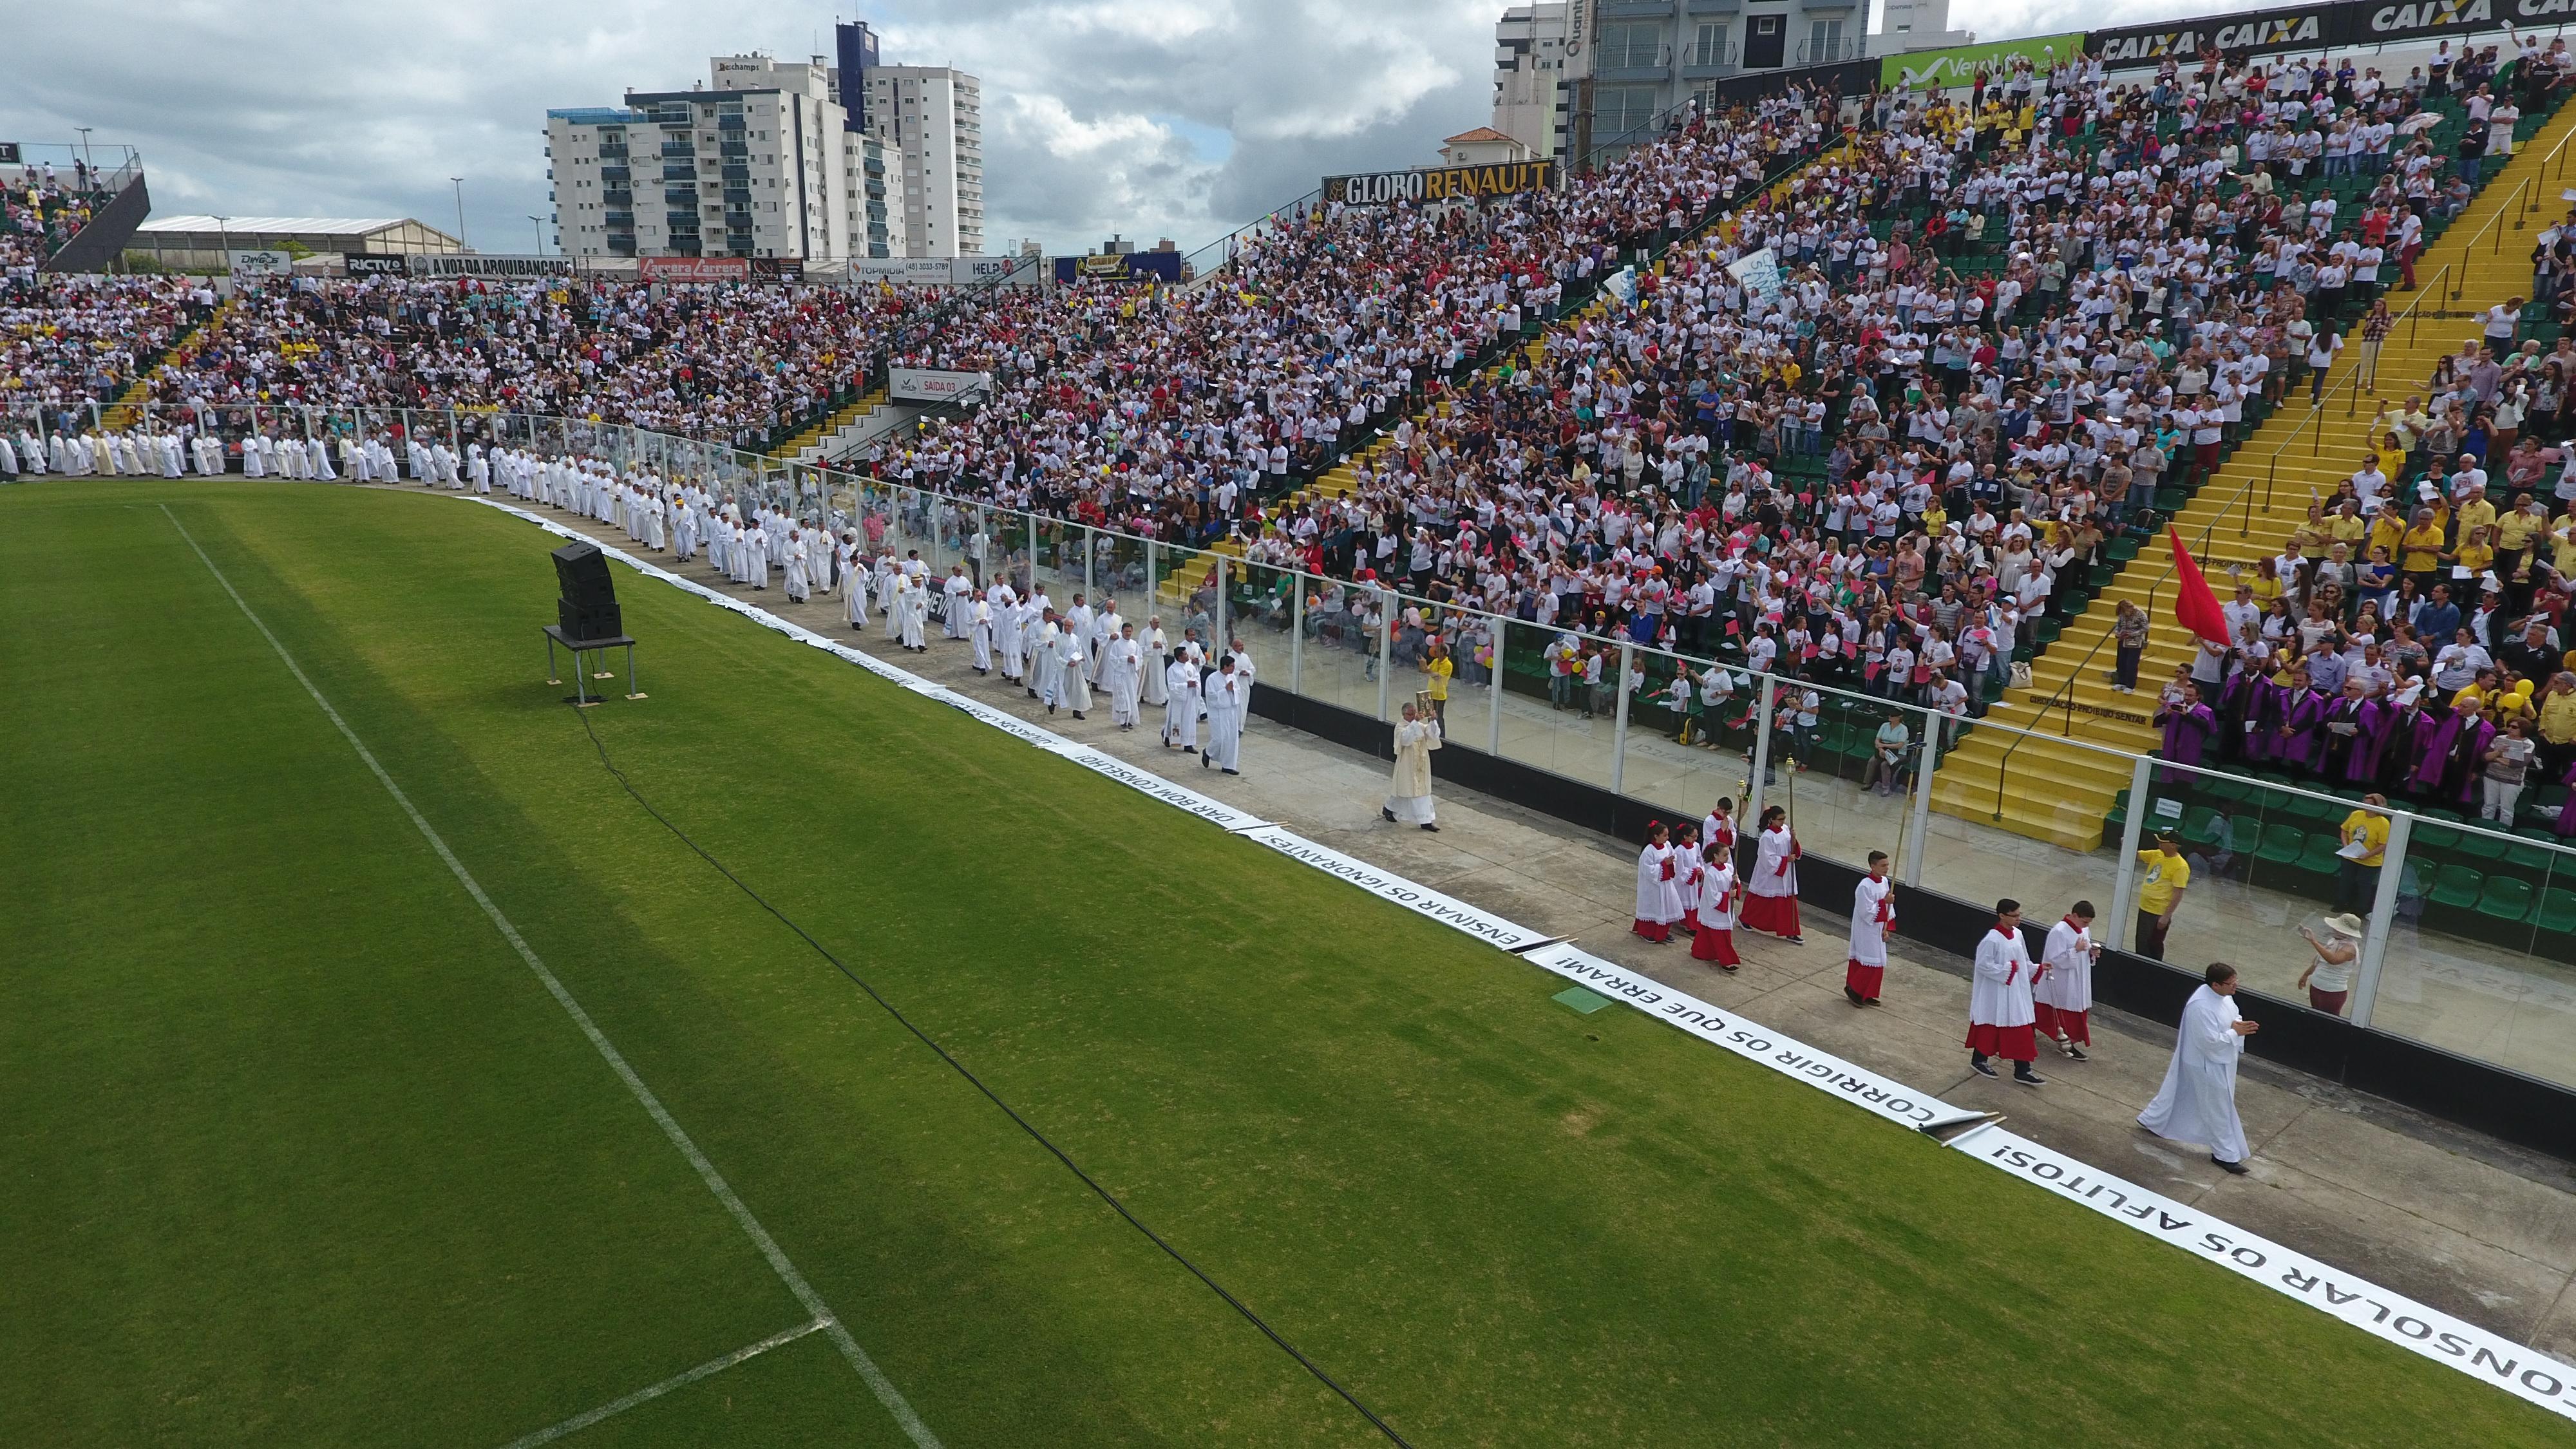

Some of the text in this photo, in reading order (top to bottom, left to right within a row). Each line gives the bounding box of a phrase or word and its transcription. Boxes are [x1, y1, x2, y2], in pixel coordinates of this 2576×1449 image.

[2372, 0, 2491, 31] CAIXA
[2518, 0, 2576, 16] CA
[2104, 31, 2195, 61] CAIXA
[2215, 16, 2318, 50] CAIXA
[717, 62, 759, 71] Deschamps
[1347, 162, 1550, 204] GLOBO RENAULT
[349, 258, 392, 270] RICTV
[433, 259, 442, 274] A
[442, 259, 462, 274] VOZ
[466, 260, 482, 274] DA
[972, 263, 999, 275] HELP
[924, 379, 956, 392] SAÍDA 03
[2116, 711, 2146, 725] SENTAR
[1075, 755, 1236, 822] DAR BOM CONSELHO!
[1262, 834, 1522, 945] ENSINAR OS IGNORANTES!
[1556, 956, 1935, 1122] CORRIGIR OS QUE ERRAM!
[1991, 1144, 2193, 1231] AFLITOS!
[2199, 1233, 2267, 1269] OS
